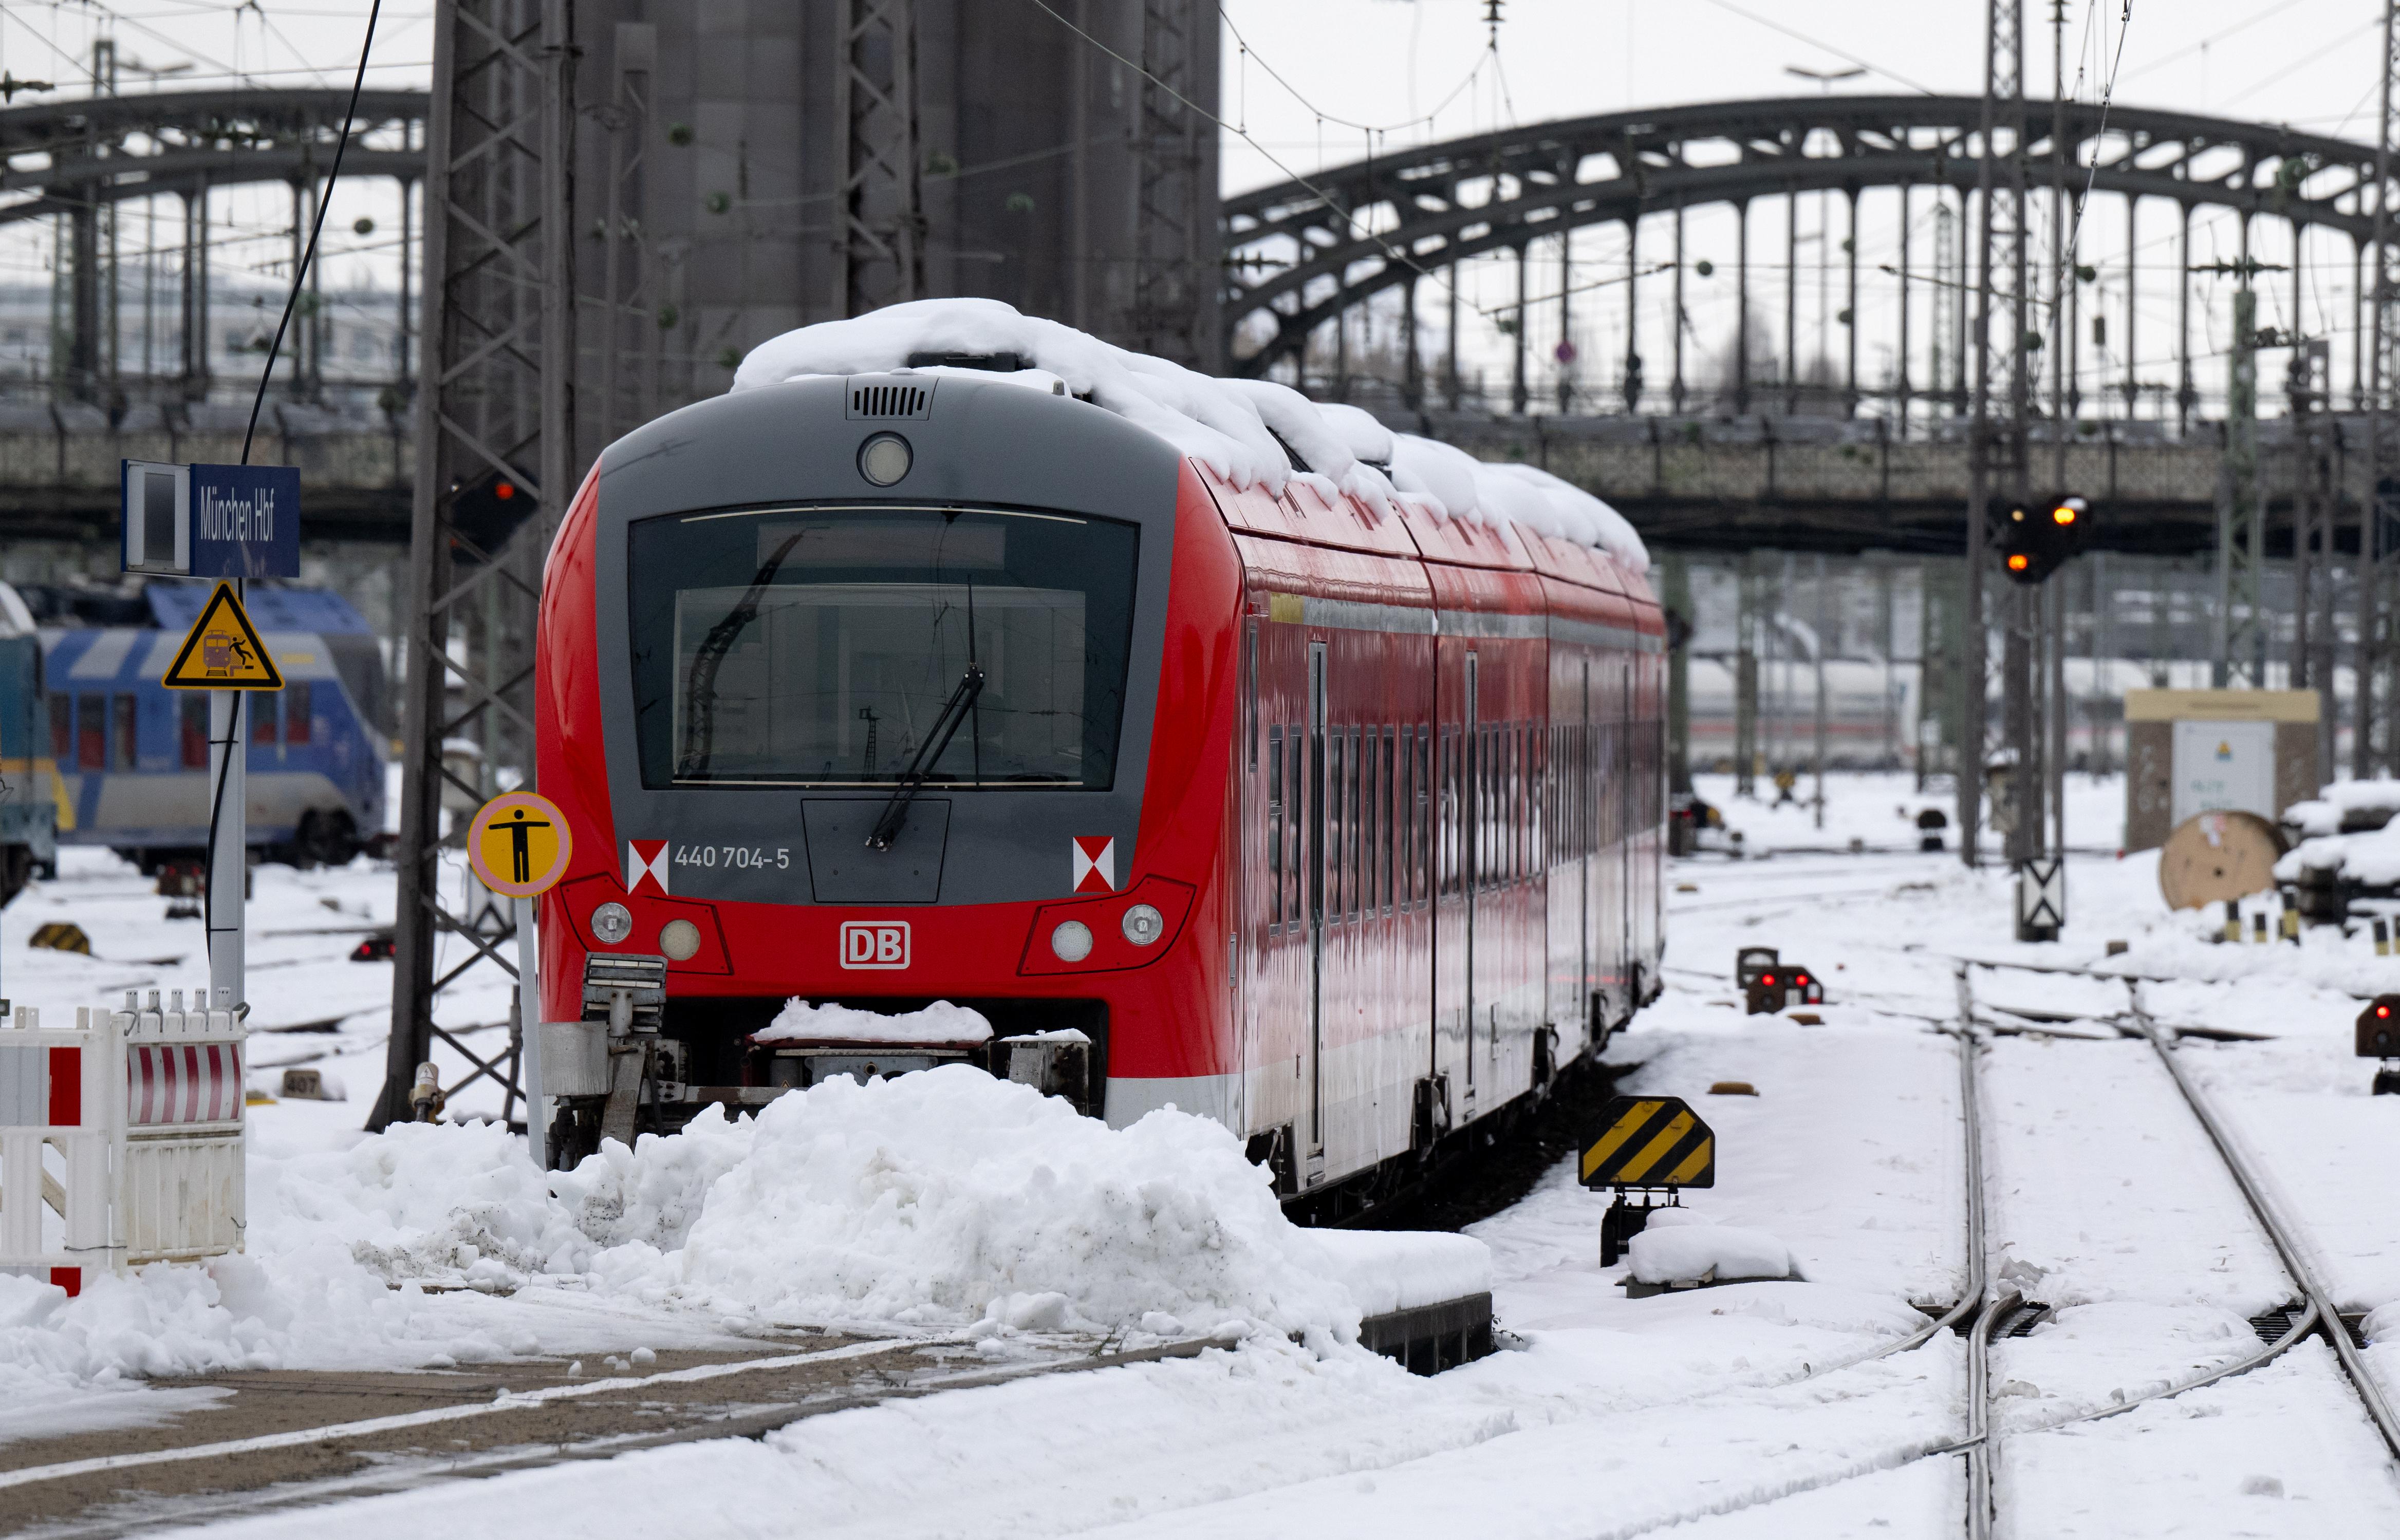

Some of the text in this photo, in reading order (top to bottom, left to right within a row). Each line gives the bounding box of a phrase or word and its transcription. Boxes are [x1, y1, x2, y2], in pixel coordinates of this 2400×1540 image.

[200, 485, 274, 541] München Hbf
[675, 845, 790, 869] 440 704-5
[848, 928, 903, 963] DB
